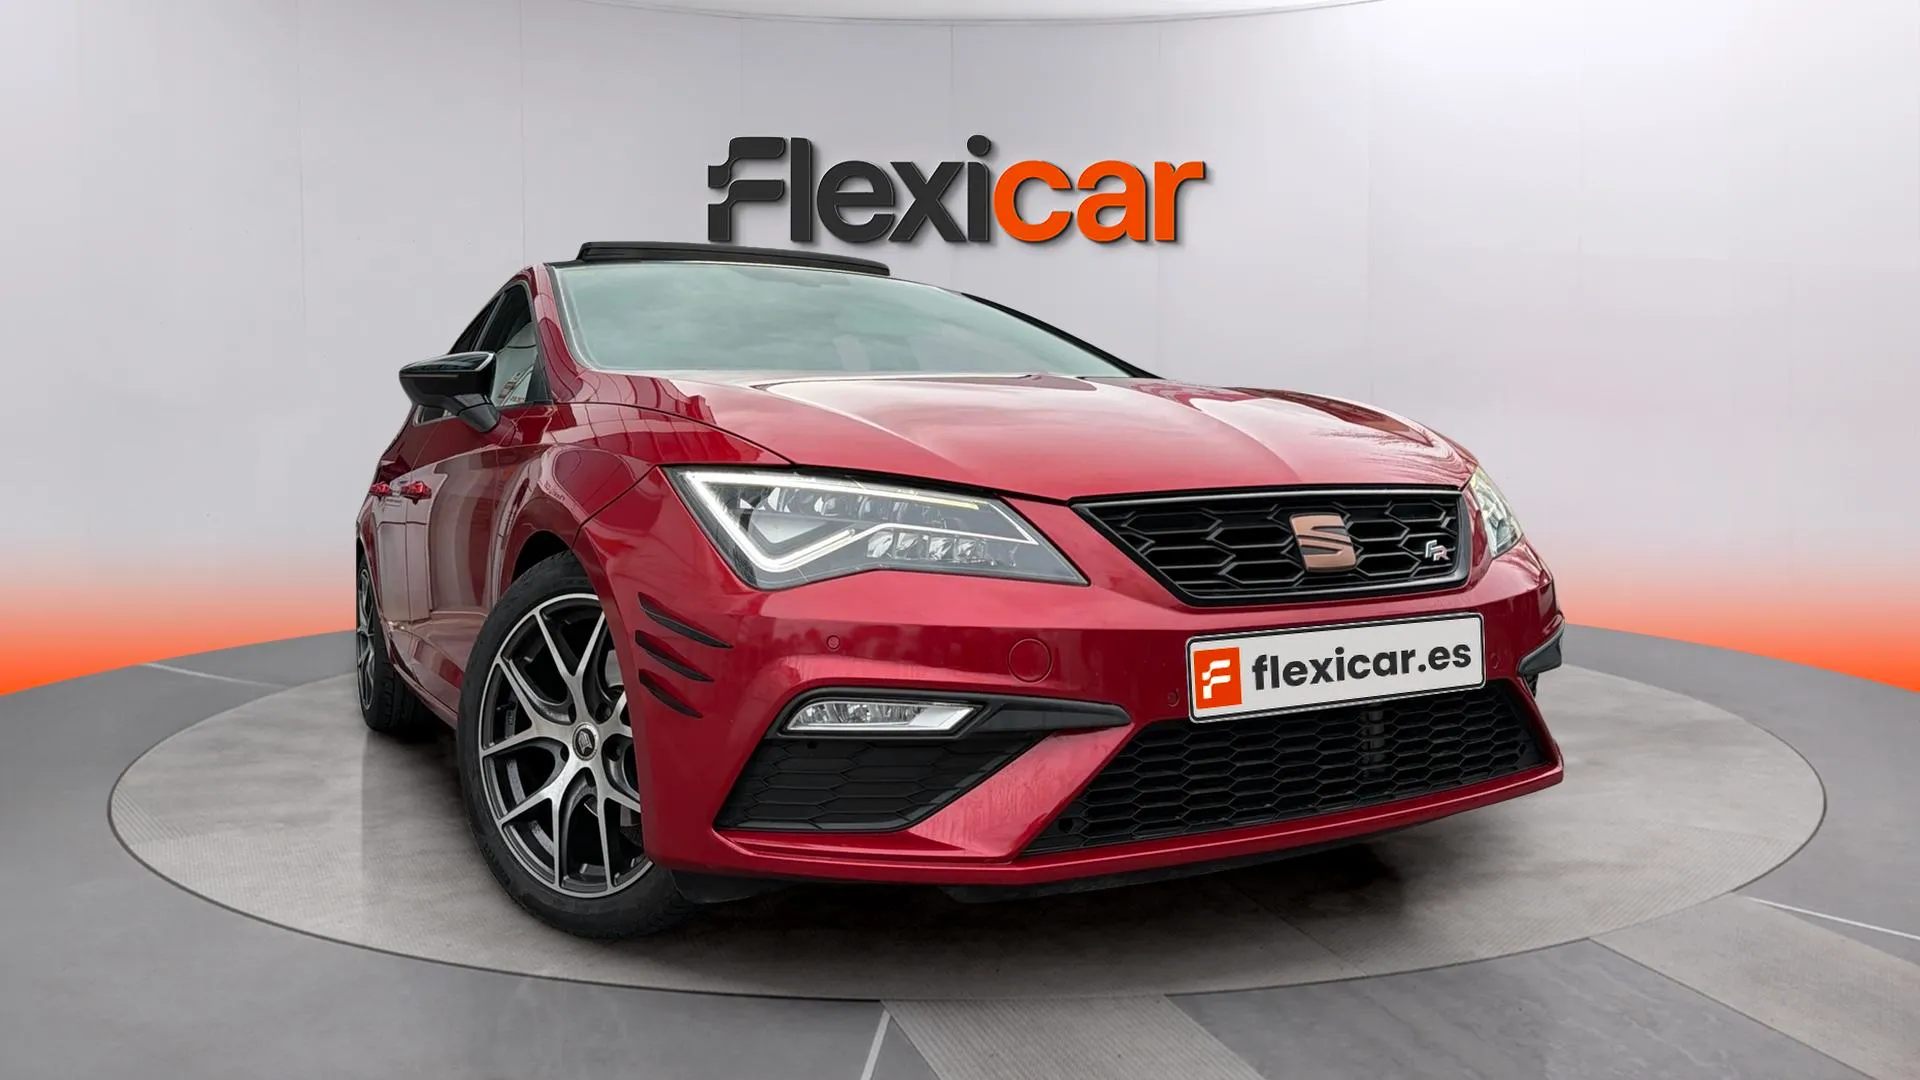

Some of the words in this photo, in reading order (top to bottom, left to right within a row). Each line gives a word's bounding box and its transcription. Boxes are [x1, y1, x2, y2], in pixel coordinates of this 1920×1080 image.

[708, 135, 1206, 243] Flexicar
[1425, 539, 1449, 561] FR
[1252, 645, 1472, 690] flexicar.es
